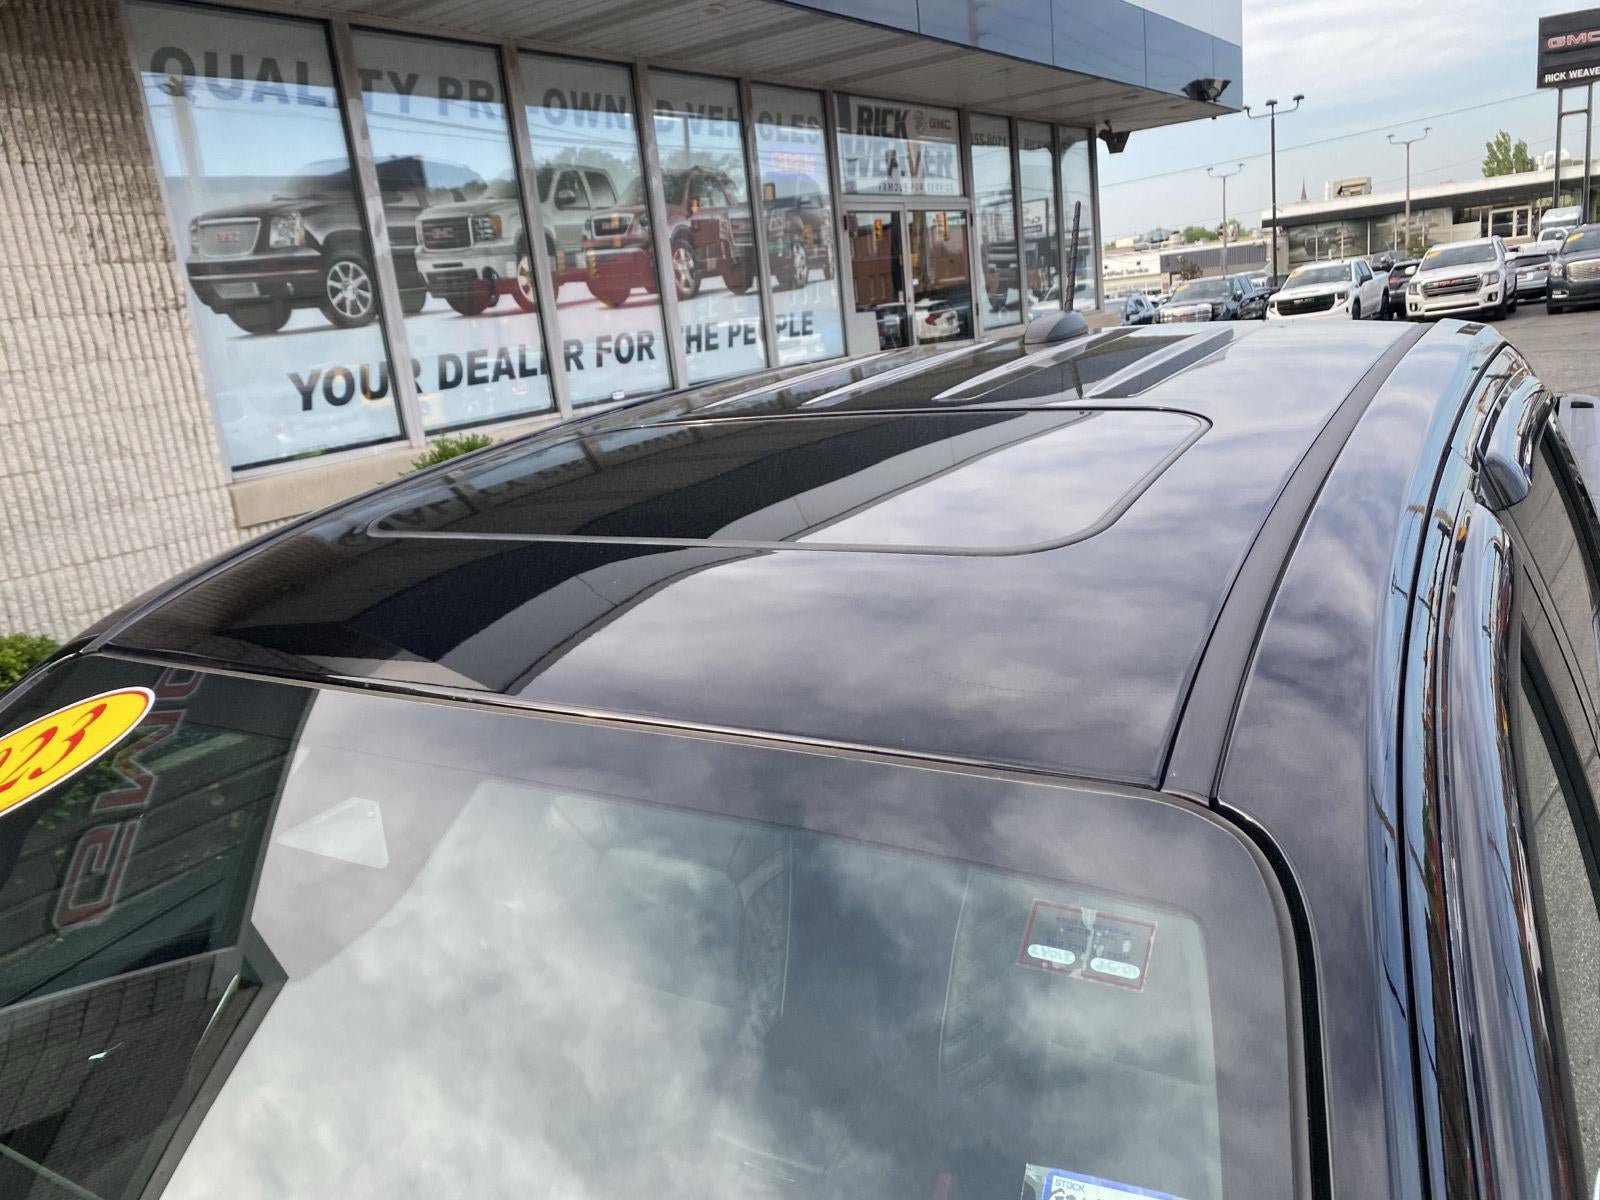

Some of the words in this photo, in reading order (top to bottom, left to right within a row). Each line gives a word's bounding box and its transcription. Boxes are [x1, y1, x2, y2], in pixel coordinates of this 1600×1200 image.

[1547, 30, 1600, 49] GMC
[150, 46, 419, 114] QUALTY
[685, 103, 820, 145] VECLES
[1544, 71, 1566, 84] RICK
[857, 105, 909, 138] RICK
[928, 118, 952, 130] GMC
[843, 139, 955, 178] WEAVER
[595, 330, 655, 367] FOR
[681, 322, 719, 353] HE
[728, 310, 813, 348] PEPLE
[0, 704, 107, 793] 23
[1055, 1179, 1086, 1193] STOCK
